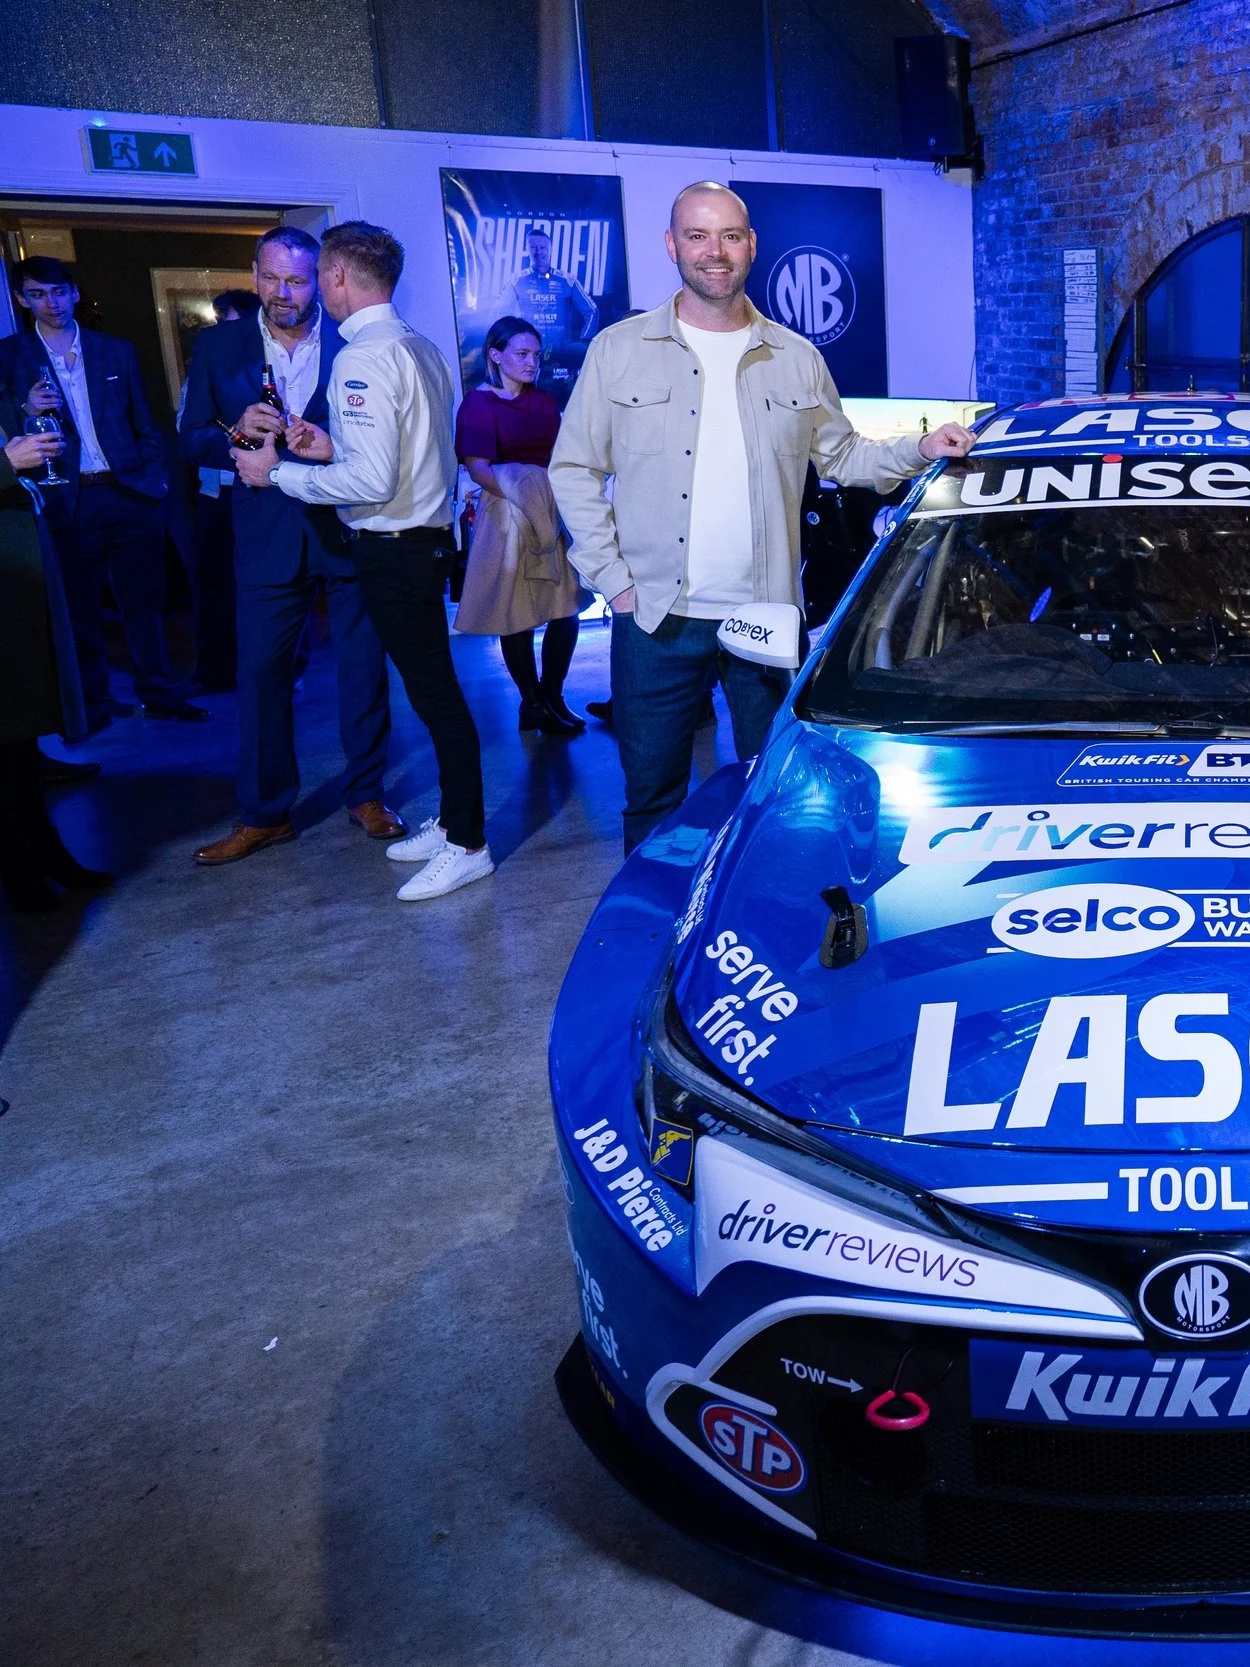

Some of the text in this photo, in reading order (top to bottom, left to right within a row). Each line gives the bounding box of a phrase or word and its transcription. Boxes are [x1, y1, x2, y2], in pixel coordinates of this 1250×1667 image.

[474, 217, 609, 296] SHEDEN
[530, 294, 556, 302] LASER
[776, 253, 843, 334] MB
[348, 395, 364, 405] STP
[1133, 434, 1250, 447] TOOLS
[1005, 898, 1181, 935] selco
[705, 930, 799, 1022] serve
[695, 994, 778, 1087] first.
[574, 1118, 673, 1252] J&D Pierce
[649, 1187, 688, 1236] Contracts Ltd
[1174, 1264, 1229, 1326] MB
[1176, 1315, 1231, 1332] MOTORSPORT
[780, 1357, 826, 1385] TOW
[713, 1414, 792, 1476] STP
